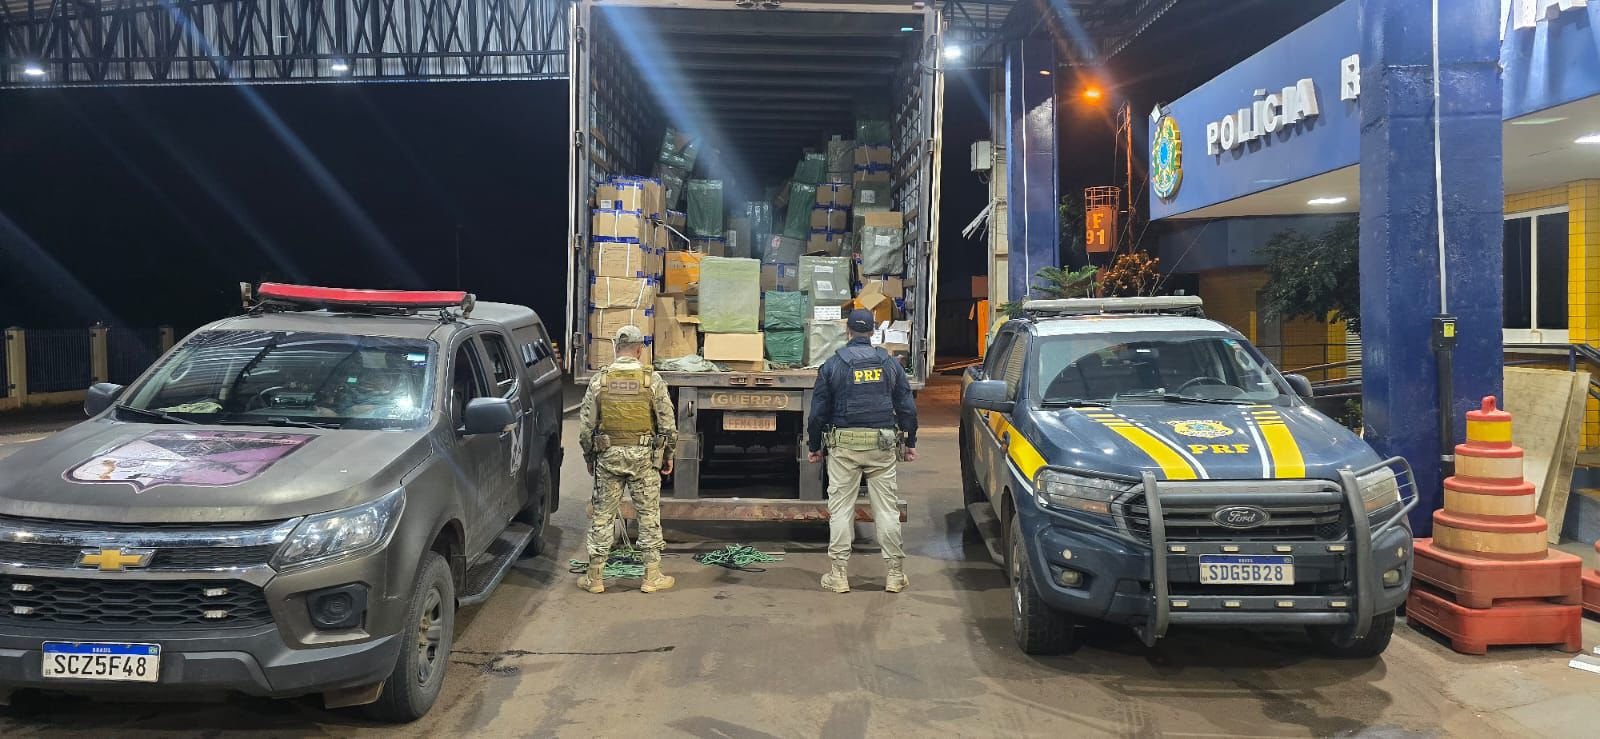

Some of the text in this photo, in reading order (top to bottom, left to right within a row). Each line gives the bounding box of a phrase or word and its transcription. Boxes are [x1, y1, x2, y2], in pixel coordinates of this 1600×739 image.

[854, 368, 883, 384] PRF
[717, 394, 783, 405] GUERRA
[1187, 443, 1251, 455] PRF
[1227, 510, 1256, 522] Ford
[1209, 564, 1283, 582] SDG5B28
[54, 654, 147, 677] SCZ5F48
